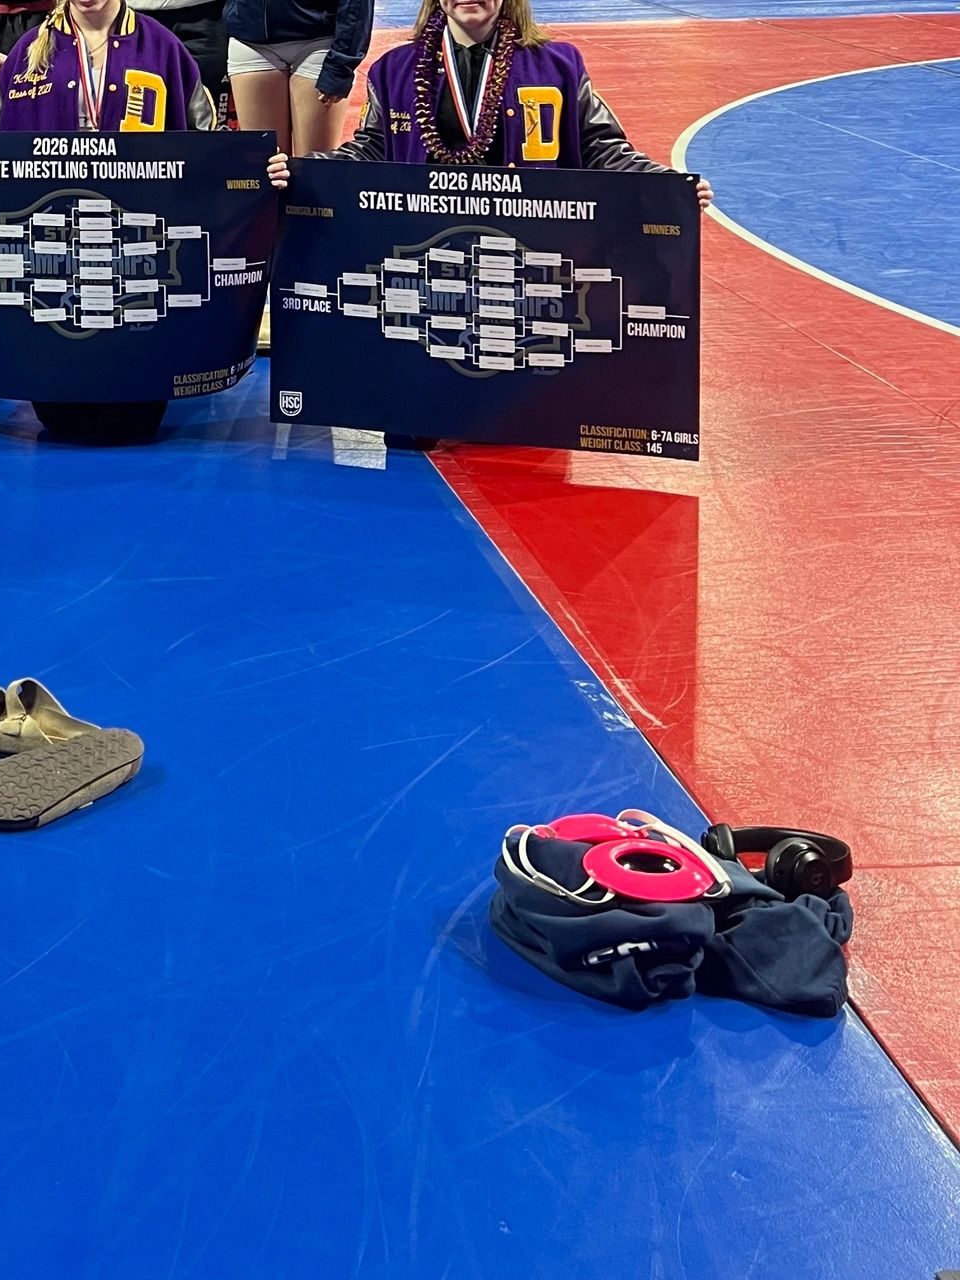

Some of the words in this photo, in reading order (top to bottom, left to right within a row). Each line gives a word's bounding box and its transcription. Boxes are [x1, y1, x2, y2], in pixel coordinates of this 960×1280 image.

[27, 86, 37, 99] of
[120, 69, 167, 132] D
[517, 86, 564, 161] D
[32, 137, 68, 156] 2026
[70, 137, 117, 156] AHSAA
[13, 160, 88, 180] WRESTLING
[90, 160, 185, 180] TOURNAMENT
[226, 179, 261, 190] WINNERS
[429, 171, 468, 190] 2026
[471, 173, 522, 193] AHSAA
[358, 191, 404, 212] STATE
[406, 194, 490, 217] WRESTLING
[493, 197, 597, 221] TOURNAMENT
[642, 224, 681, 237] WINNERS
[214, 270, 263, 287] CHAMPION
[282, 297, 301, 312] 3RD
[302, 299, 332, 314] PLACE
[627, 321, 686, 340] CHAMPION
[173, 384, 202, 397] WEIGHT
[282, 395, 300, 409] HSC
[580, 424, 649, 440] CLASSIFICATION:
[651, 430, 673, 443] 6-7A
[674, 432, 700, 445] GIRLS
[580, 437, 612, 450] WEIGHT
[613, 439, 644, 452] CLASS:
[646, 442, 663, 454] 145
